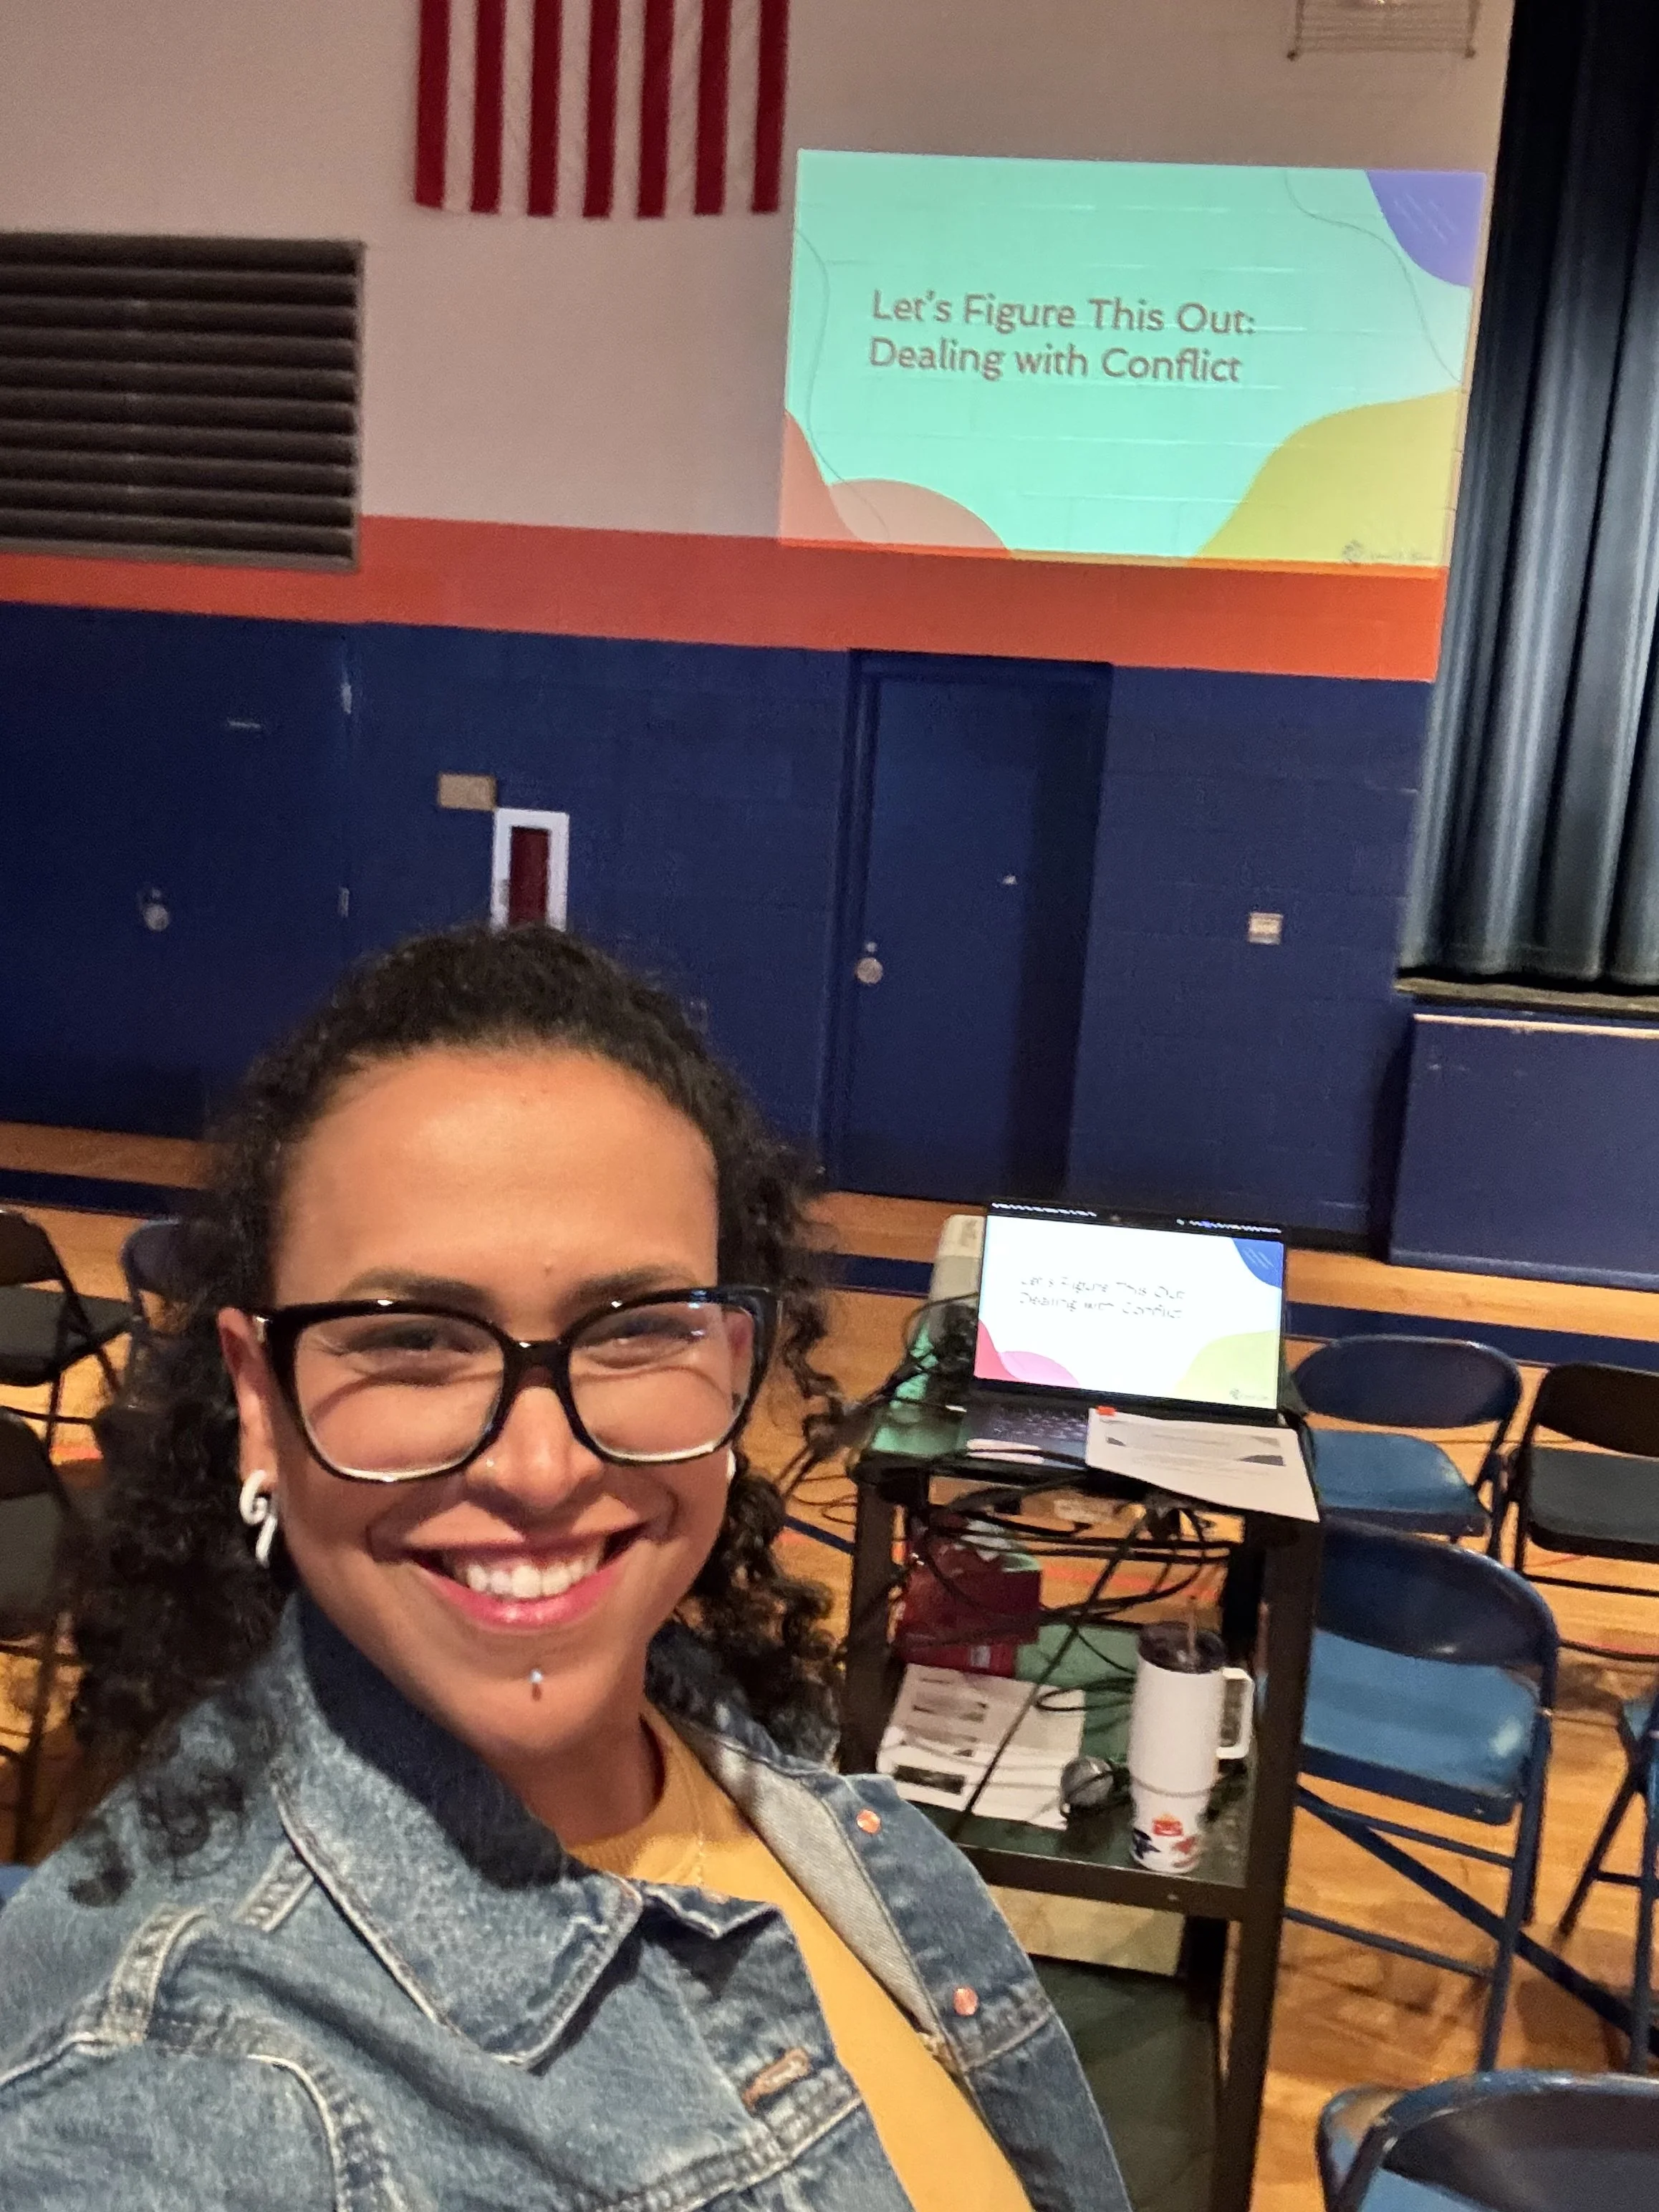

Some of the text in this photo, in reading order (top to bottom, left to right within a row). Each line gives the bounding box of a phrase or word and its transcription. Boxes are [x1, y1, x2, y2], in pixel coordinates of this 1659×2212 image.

[872, 288, 1256, 336] Let's Figure This Out:
[869, 336, 1243, 383] Dealing with Conflict
